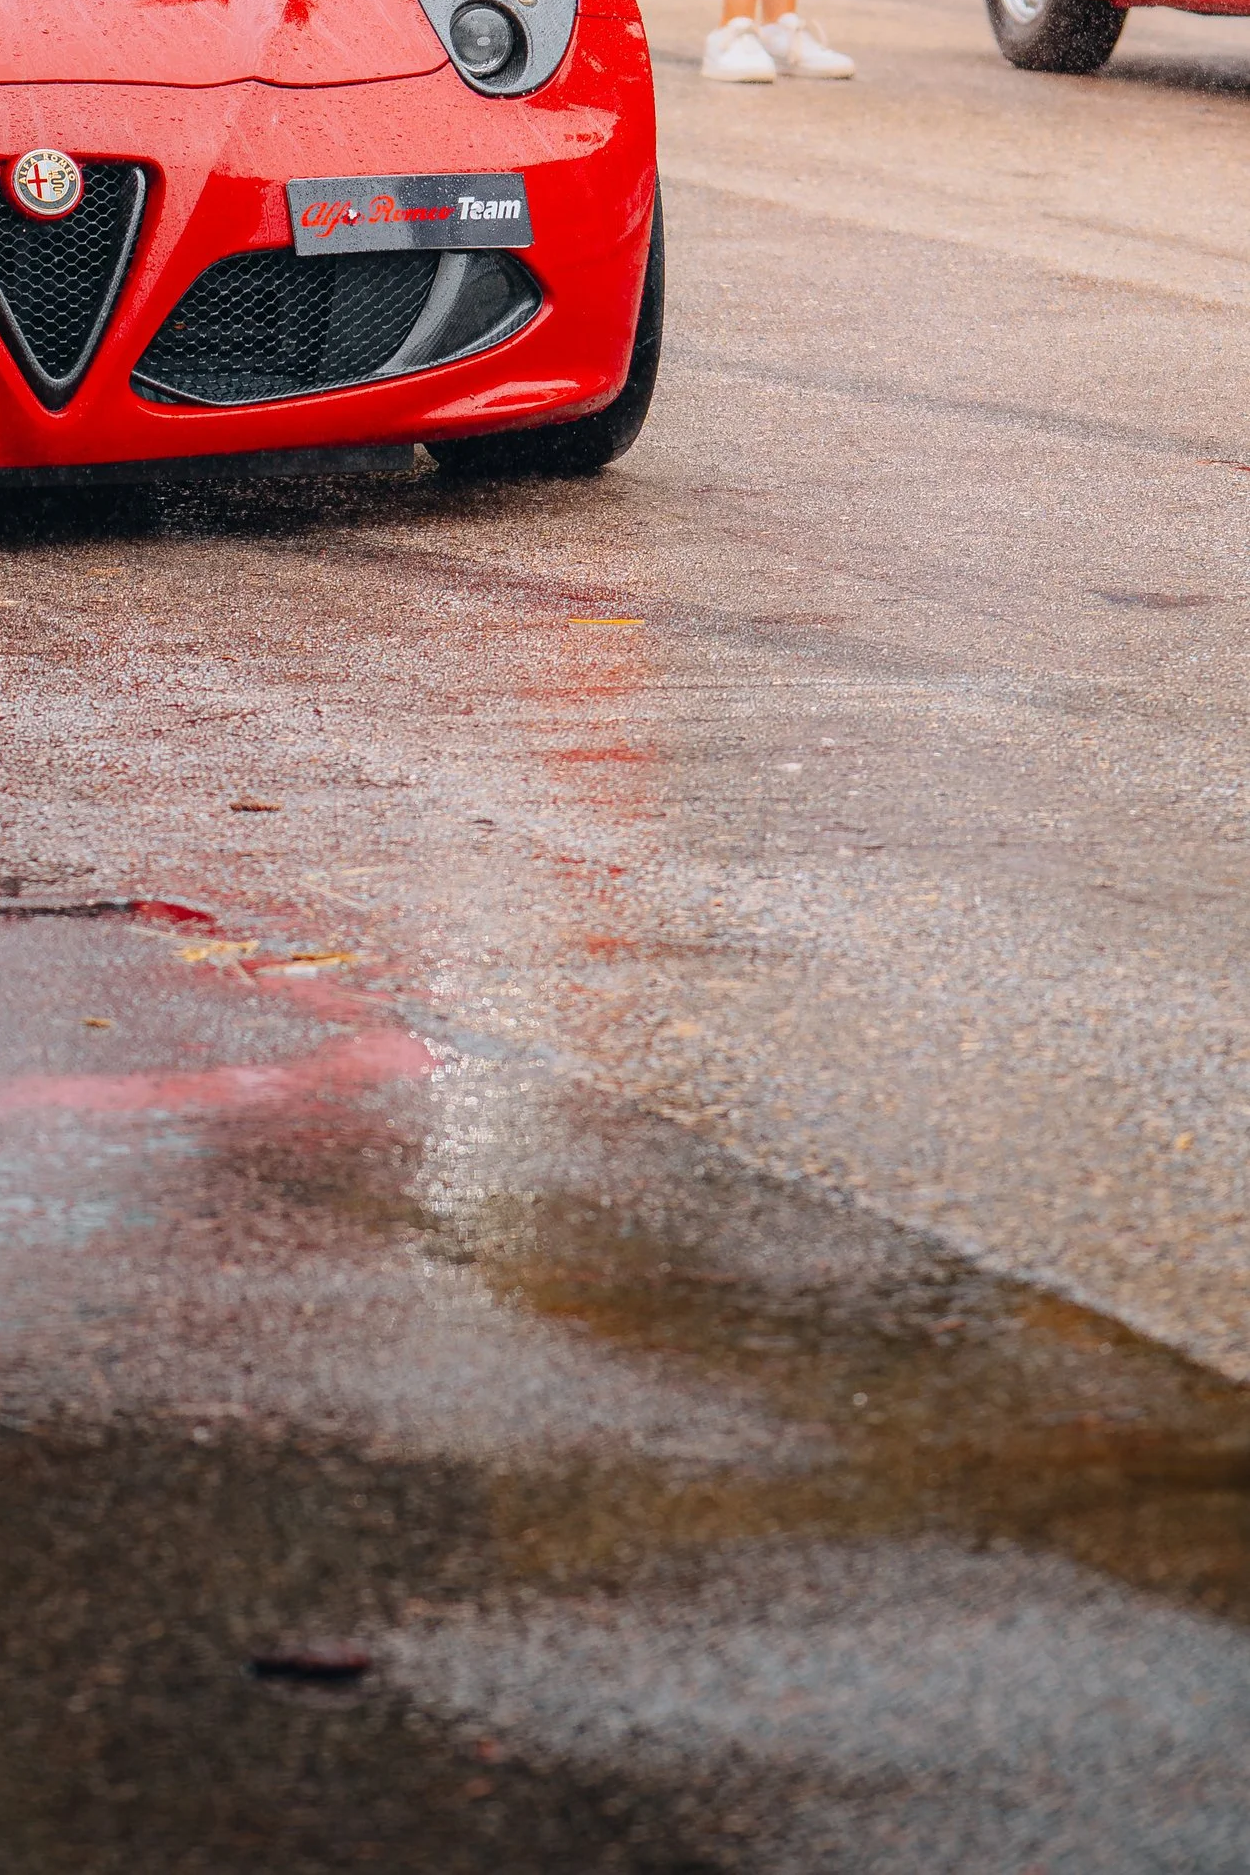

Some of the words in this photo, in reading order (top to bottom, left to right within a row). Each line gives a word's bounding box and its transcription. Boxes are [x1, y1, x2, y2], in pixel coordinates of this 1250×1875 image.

[18, 157, 38, 185] ALFA
[43, 153, 76, 182] ROMEO
[368, 194, 455, 224] Romeo
[458, 196, 521, 220] Team
